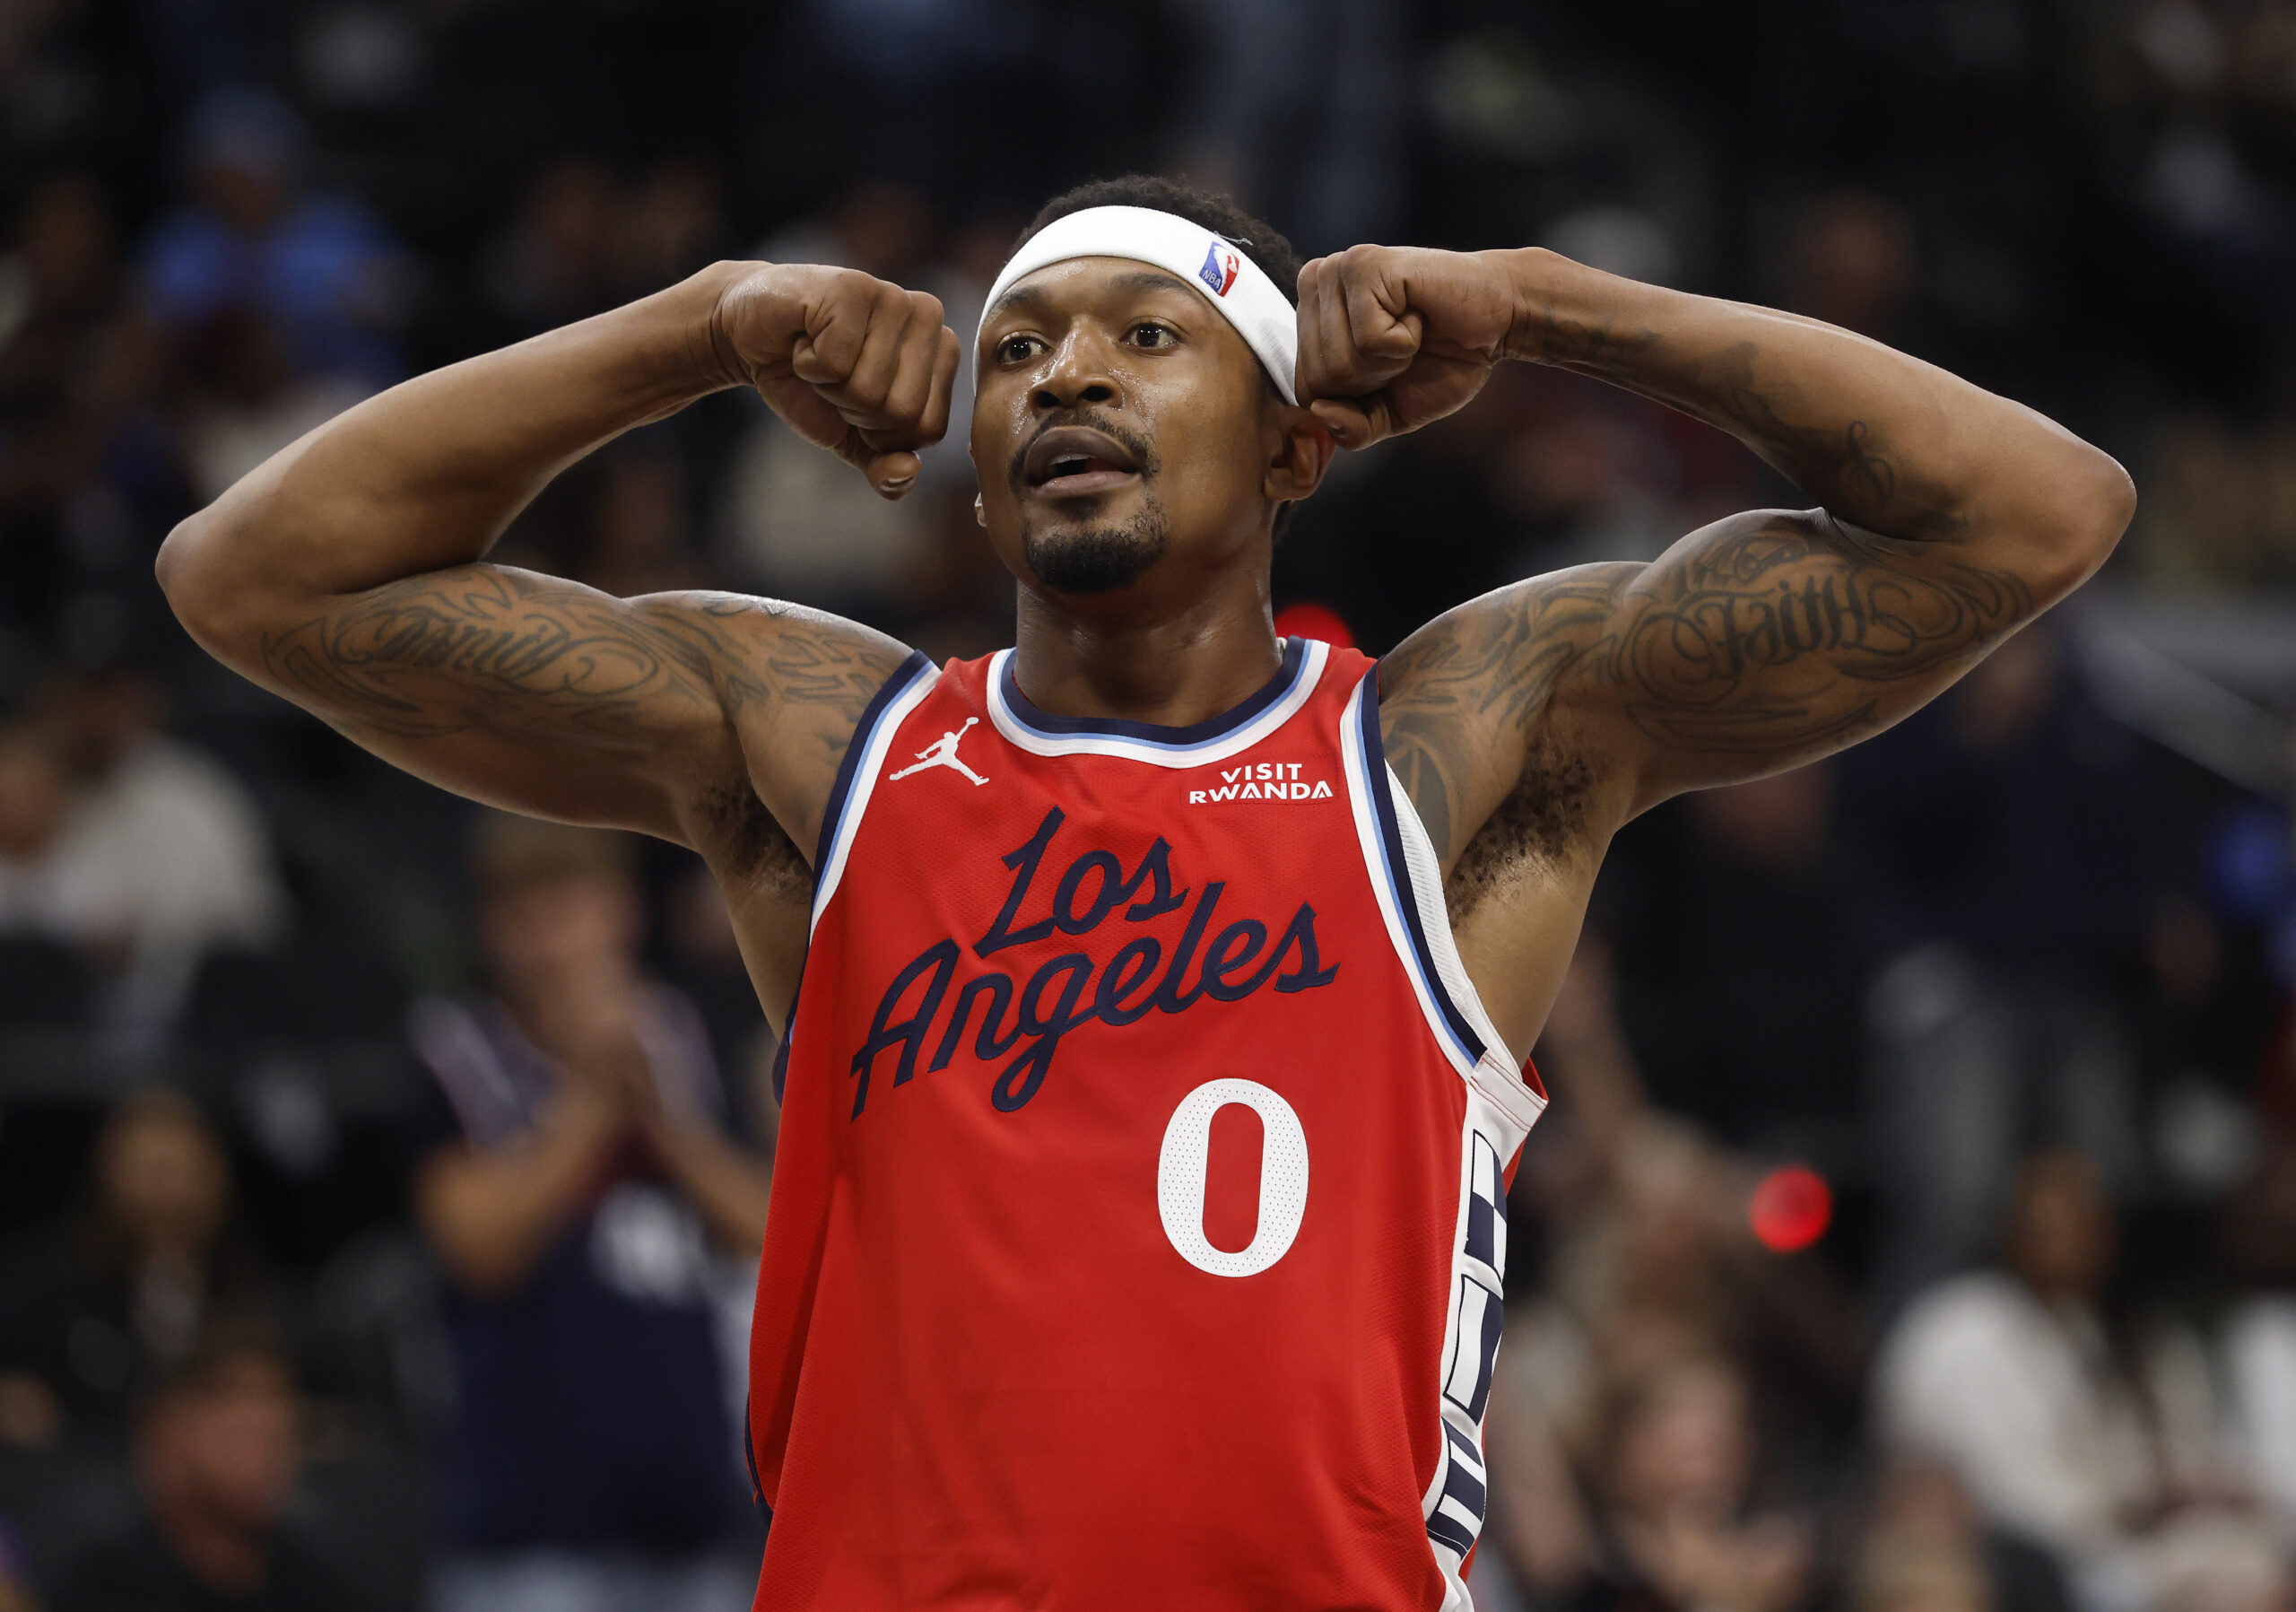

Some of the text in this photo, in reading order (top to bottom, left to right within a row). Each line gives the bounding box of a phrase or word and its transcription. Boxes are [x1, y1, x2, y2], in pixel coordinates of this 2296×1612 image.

[1202, 269, 1222, 289] NBA
[1189, 780, 1334, 805] RWANDA
[1220, 762, 1302, 784] VISIT
[972, 805, 1190, 960] Los
[849, 880, 1341, 1122] Angeles
[1157, 1077, 1309, 1278] 0
